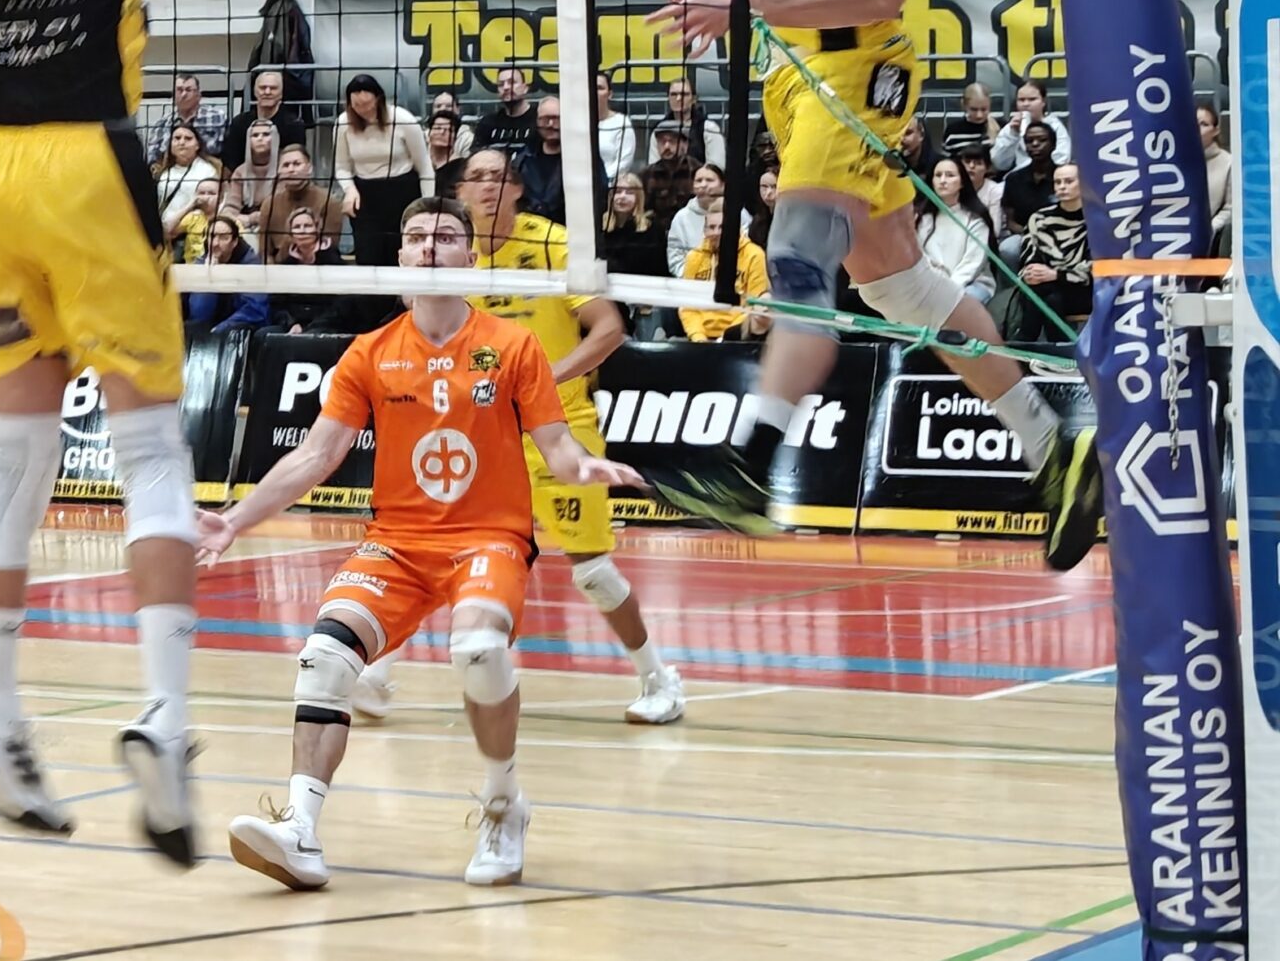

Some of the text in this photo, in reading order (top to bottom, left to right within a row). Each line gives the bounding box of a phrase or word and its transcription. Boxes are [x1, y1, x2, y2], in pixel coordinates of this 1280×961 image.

[1129, 44, 1171, 114] OY
[433, 379, 450, 414] 6
[1183, 620, 1223, 692] OY
